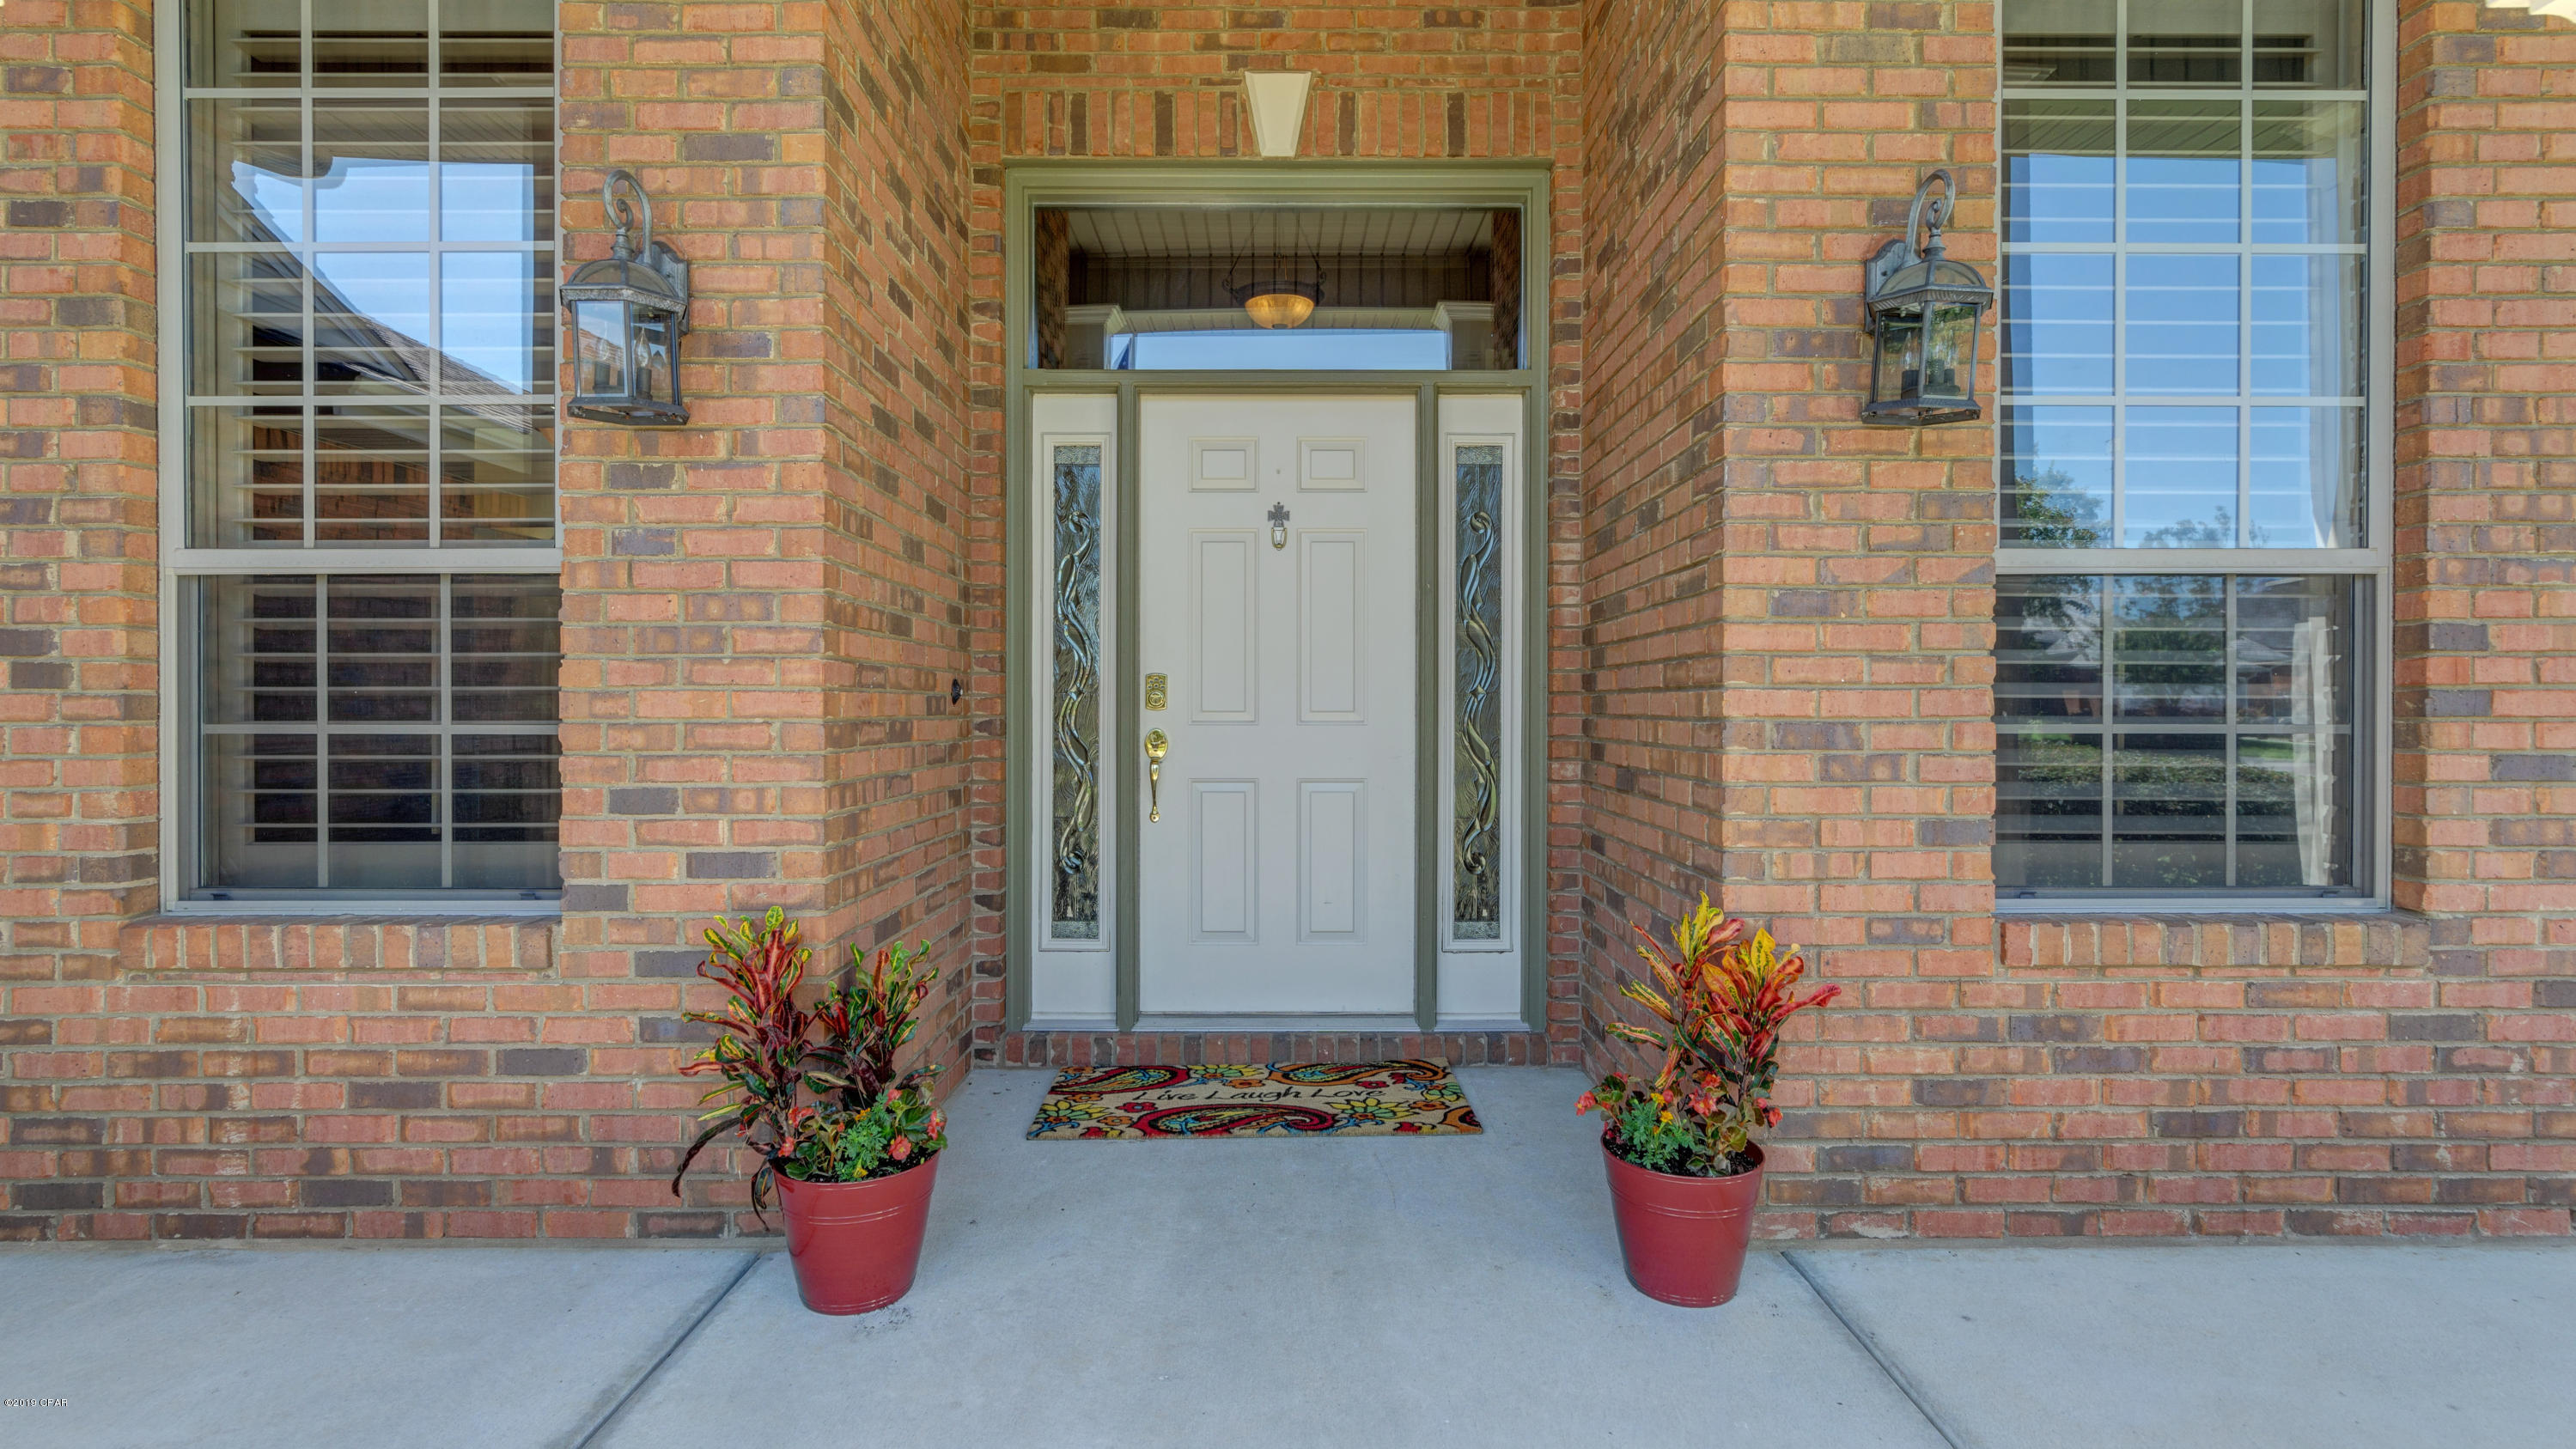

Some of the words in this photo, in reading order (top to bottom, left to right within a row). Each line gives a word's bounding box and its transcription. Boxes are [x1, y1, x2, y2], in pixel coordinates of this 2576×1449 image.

[1132, 1090, 1199, 1100] Live
[1205, 1087, 1302, 1102] Laugh
[1311, 1088, 1386, 1098] Love
